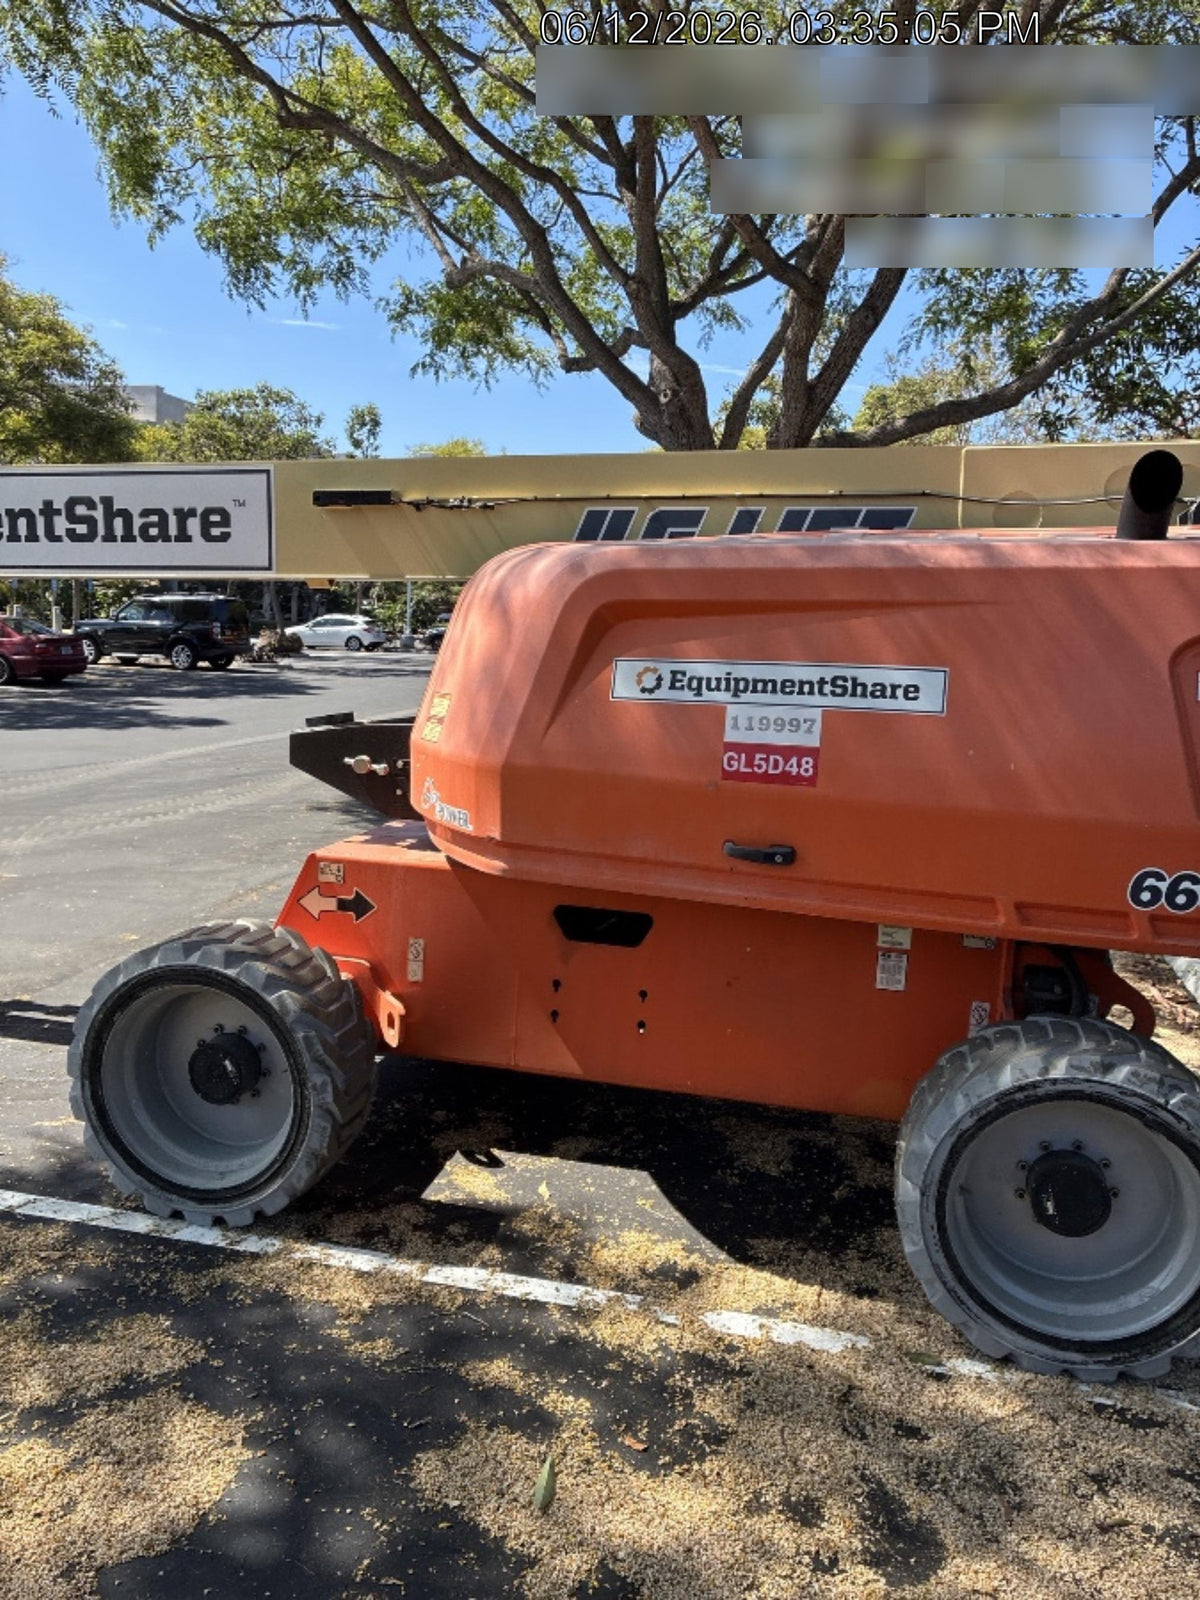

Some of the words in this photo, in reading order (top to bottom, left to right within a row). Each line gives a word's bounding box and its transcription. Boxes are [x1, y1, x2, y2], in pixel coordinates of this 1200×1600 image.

[0, 495, 231, 543] ntShare
[667, 669, 920, 701] EquipmentShare
[730, 713, 817, 735] 119997
[722, 751, 814, 777] GL5D48
[1127, 866, 1200, 914] 66
